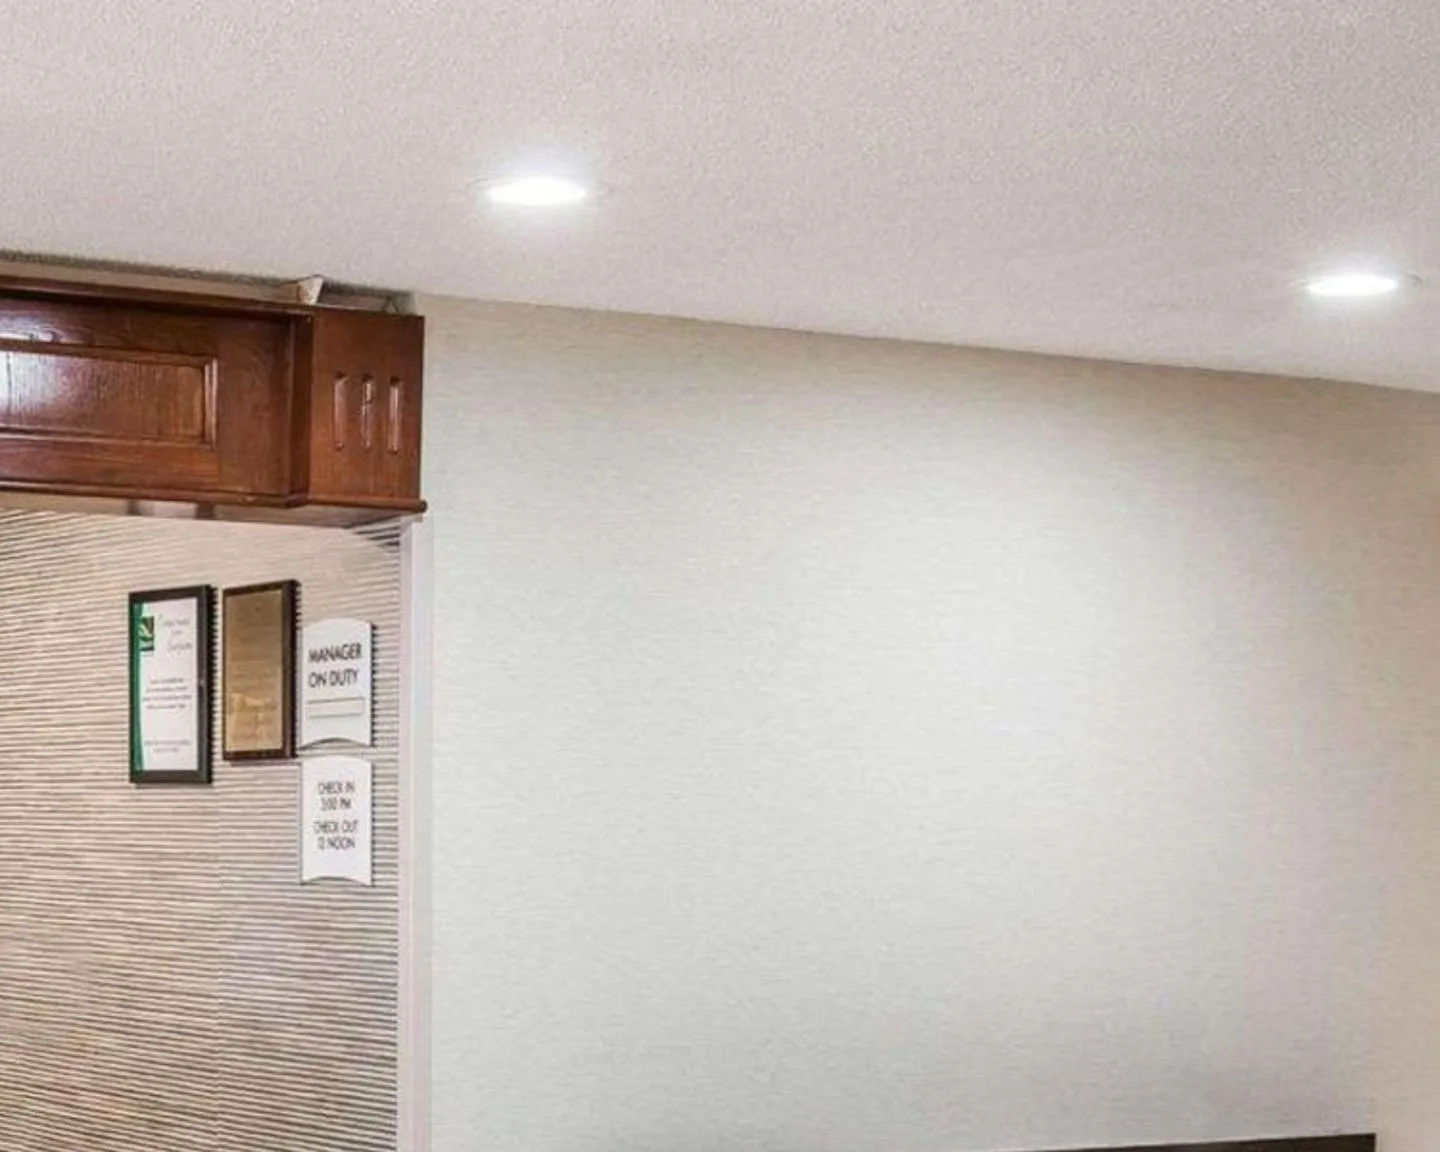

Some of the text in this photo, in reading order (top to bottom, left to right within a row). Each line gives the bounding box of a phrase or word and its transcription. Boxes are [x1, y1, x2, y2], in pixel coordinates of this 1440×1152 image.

[308, 642, 362, 662] MANAGER
[308, 668, 359, 688] ON DUTY
